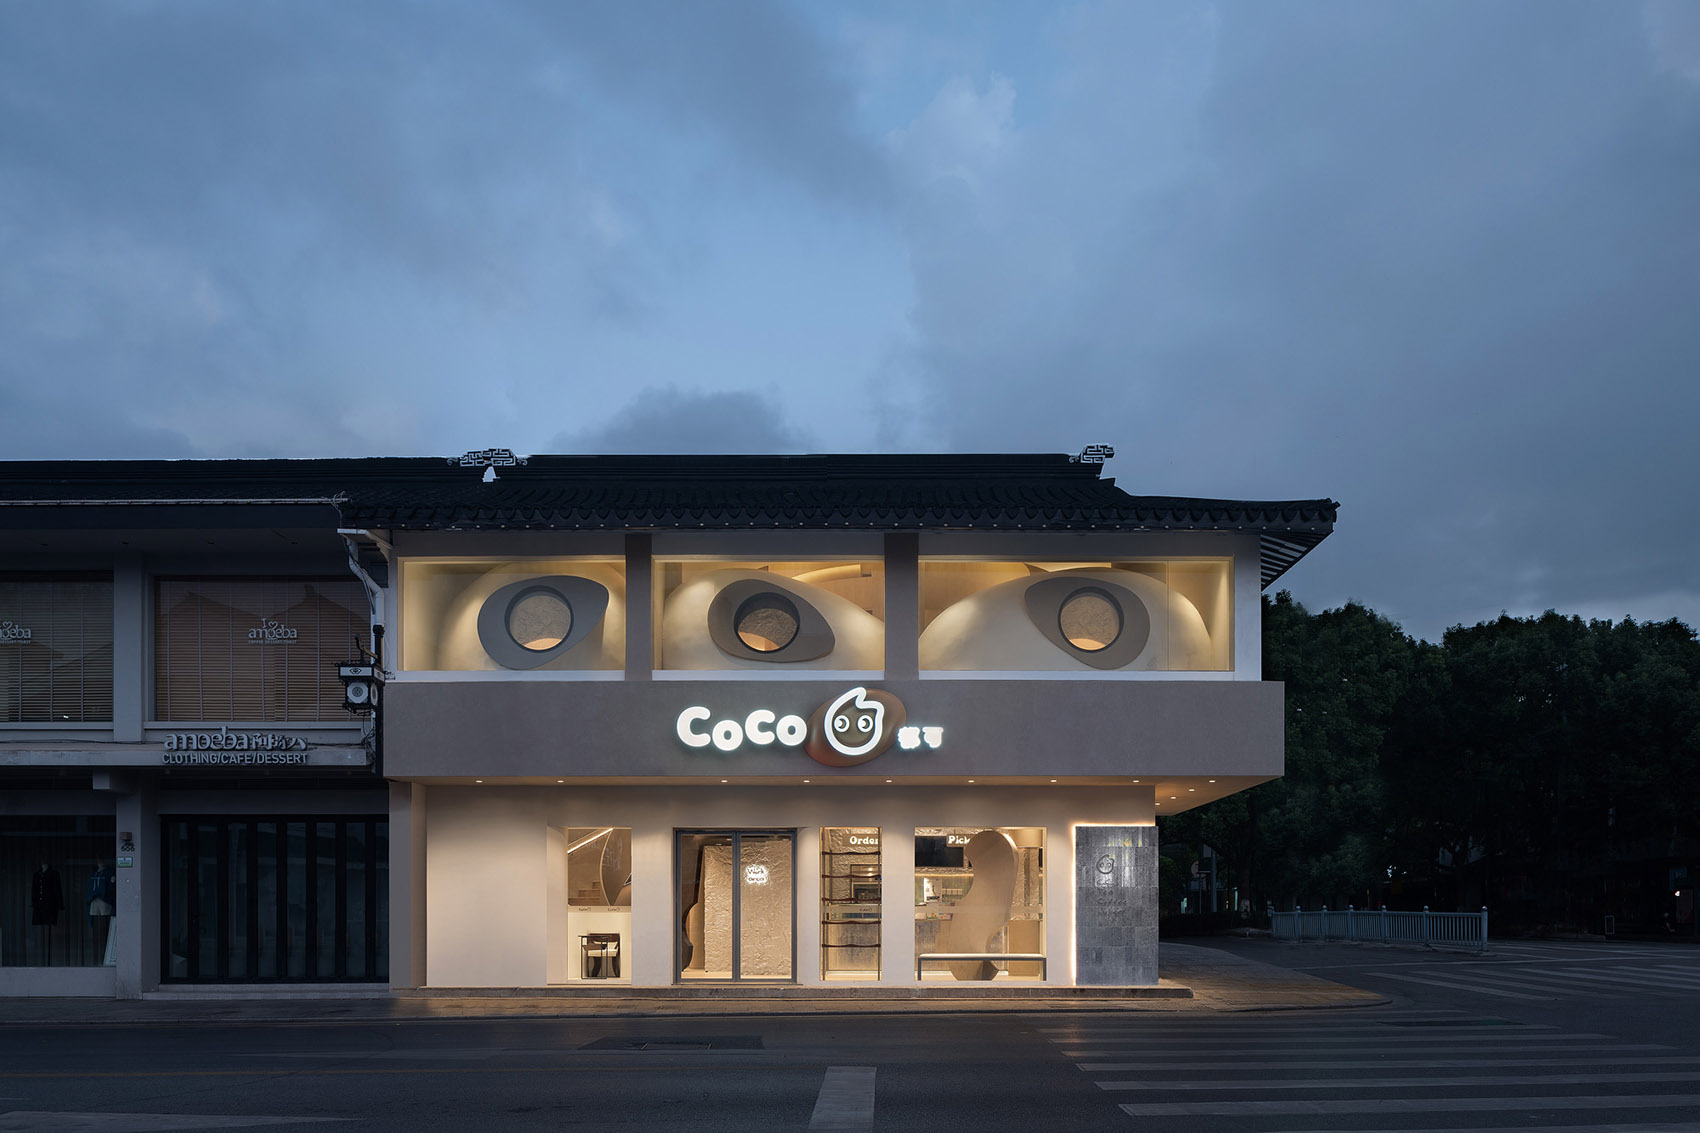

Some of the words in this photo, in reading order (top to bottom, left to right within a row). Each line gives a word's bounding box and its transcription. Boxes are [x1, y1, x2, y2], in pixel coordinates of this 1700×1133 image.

[0, 624, 31, 639] oeba
[248, 624, 298, 639] amoeba
[164, 725, 249, 750] amoeba
[676, 706, 808, 752] CoCo
